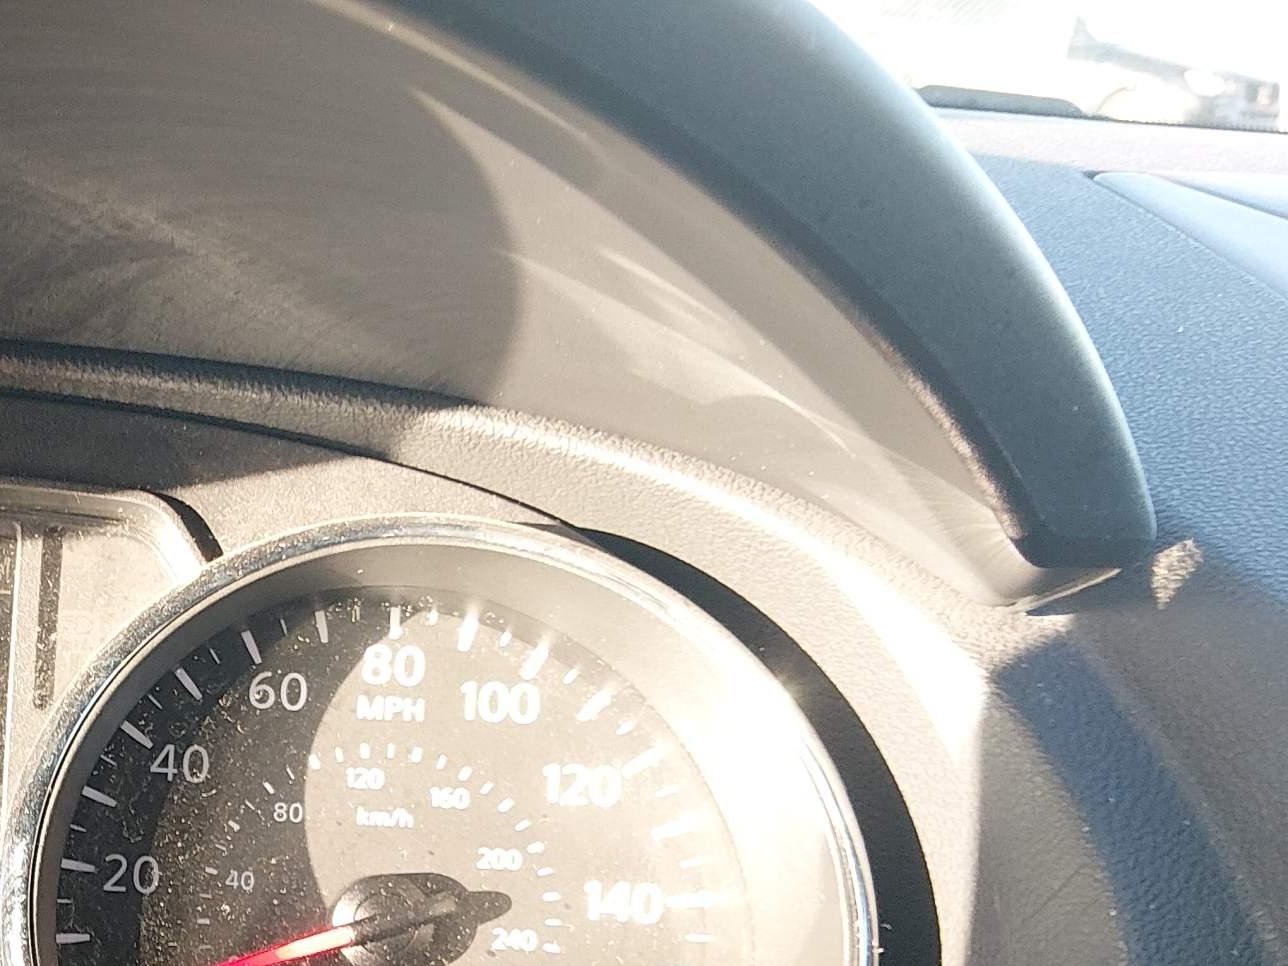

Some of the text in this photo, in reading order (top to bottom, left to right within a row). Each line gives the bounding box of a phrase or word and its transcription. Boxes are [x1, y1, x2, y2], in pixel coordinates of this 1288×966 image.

[361, 643, 426, 688] 80
[248, 672, 308, 712] 60
[460, 680, 541, 725] 100
[356, 694, 425, 722] MPH
[149, 743, 209, 784] 40
[345, 767, 386, 790] 120
[542, 762, 622, 808] 120
[429, 786, 471, 810] 160
[273, 802, 303, 823] 80
[356, 806, 415, 828] km/h
[476, 846, 523, 871] 200
[103, 853, 159, 895] 20
[224, 868, 254, 891] 40
[584, 879, 663, 925] 140
[491, 927, 538, 952] 240
